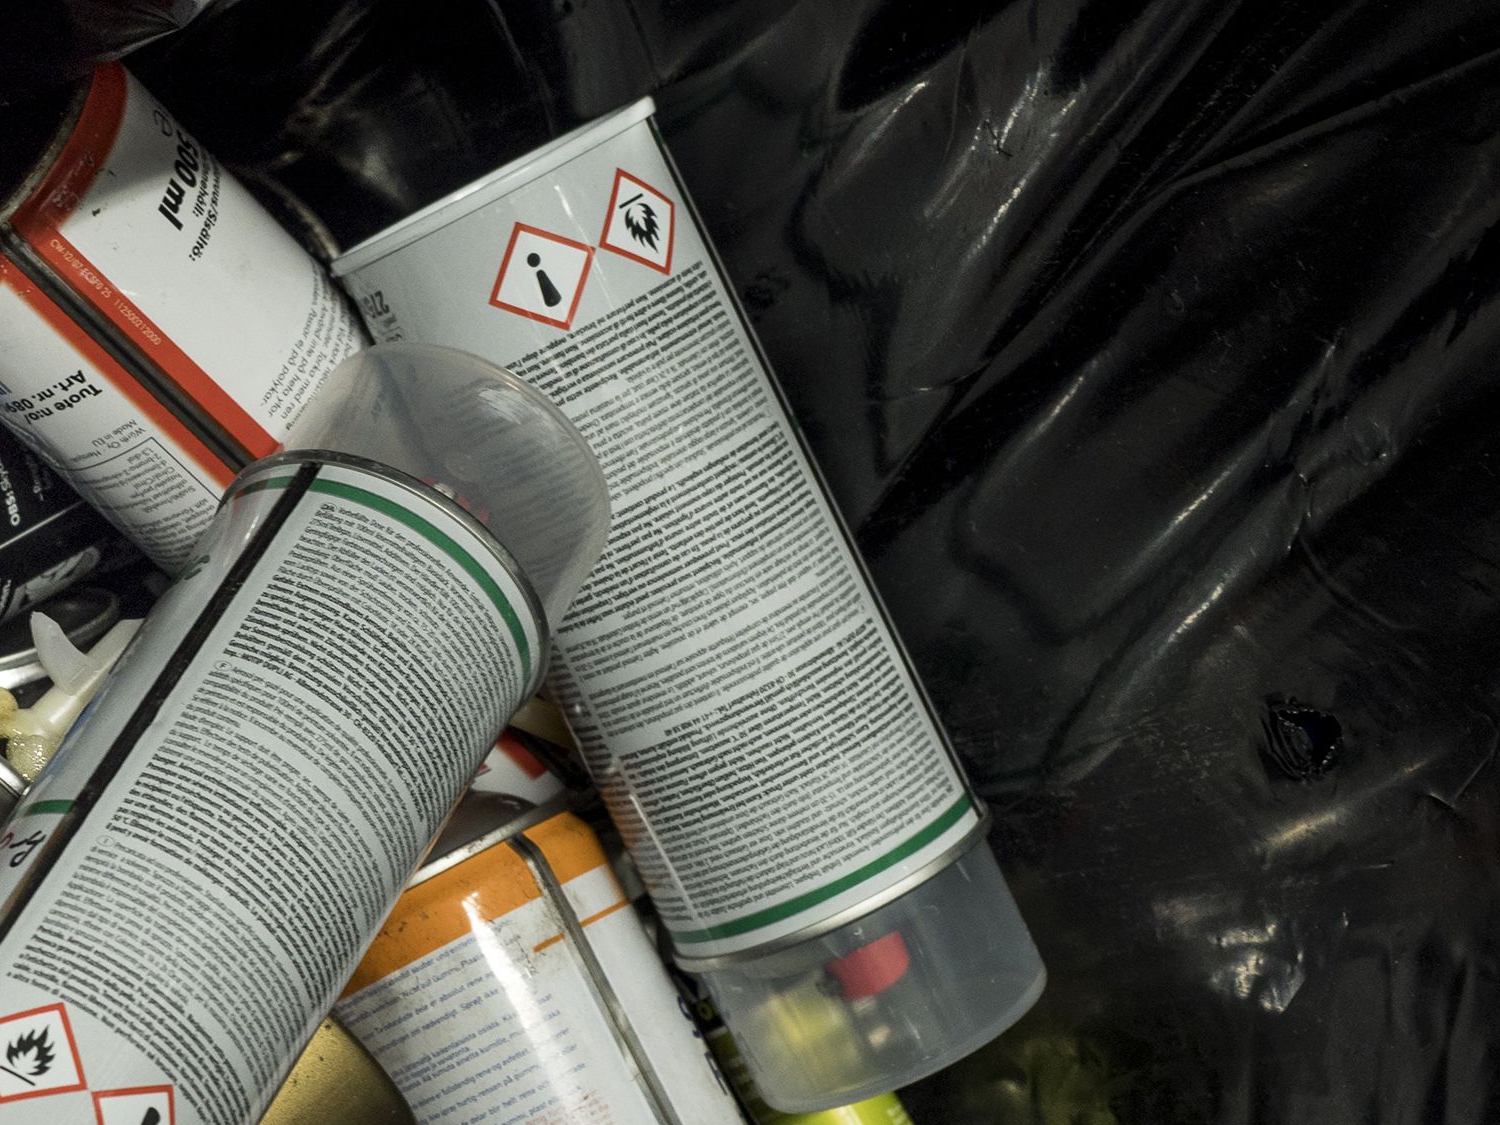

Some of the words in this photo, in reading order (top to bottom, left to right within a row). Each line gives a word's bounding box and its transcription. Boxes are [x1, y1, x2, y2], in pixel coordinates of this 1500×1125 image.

[156, 177, 186, 230] ml
[52, 369, 87, 394] Art.
[31, 387, 54, 403] nr.
[54, 383, 102, 409] Tuote
